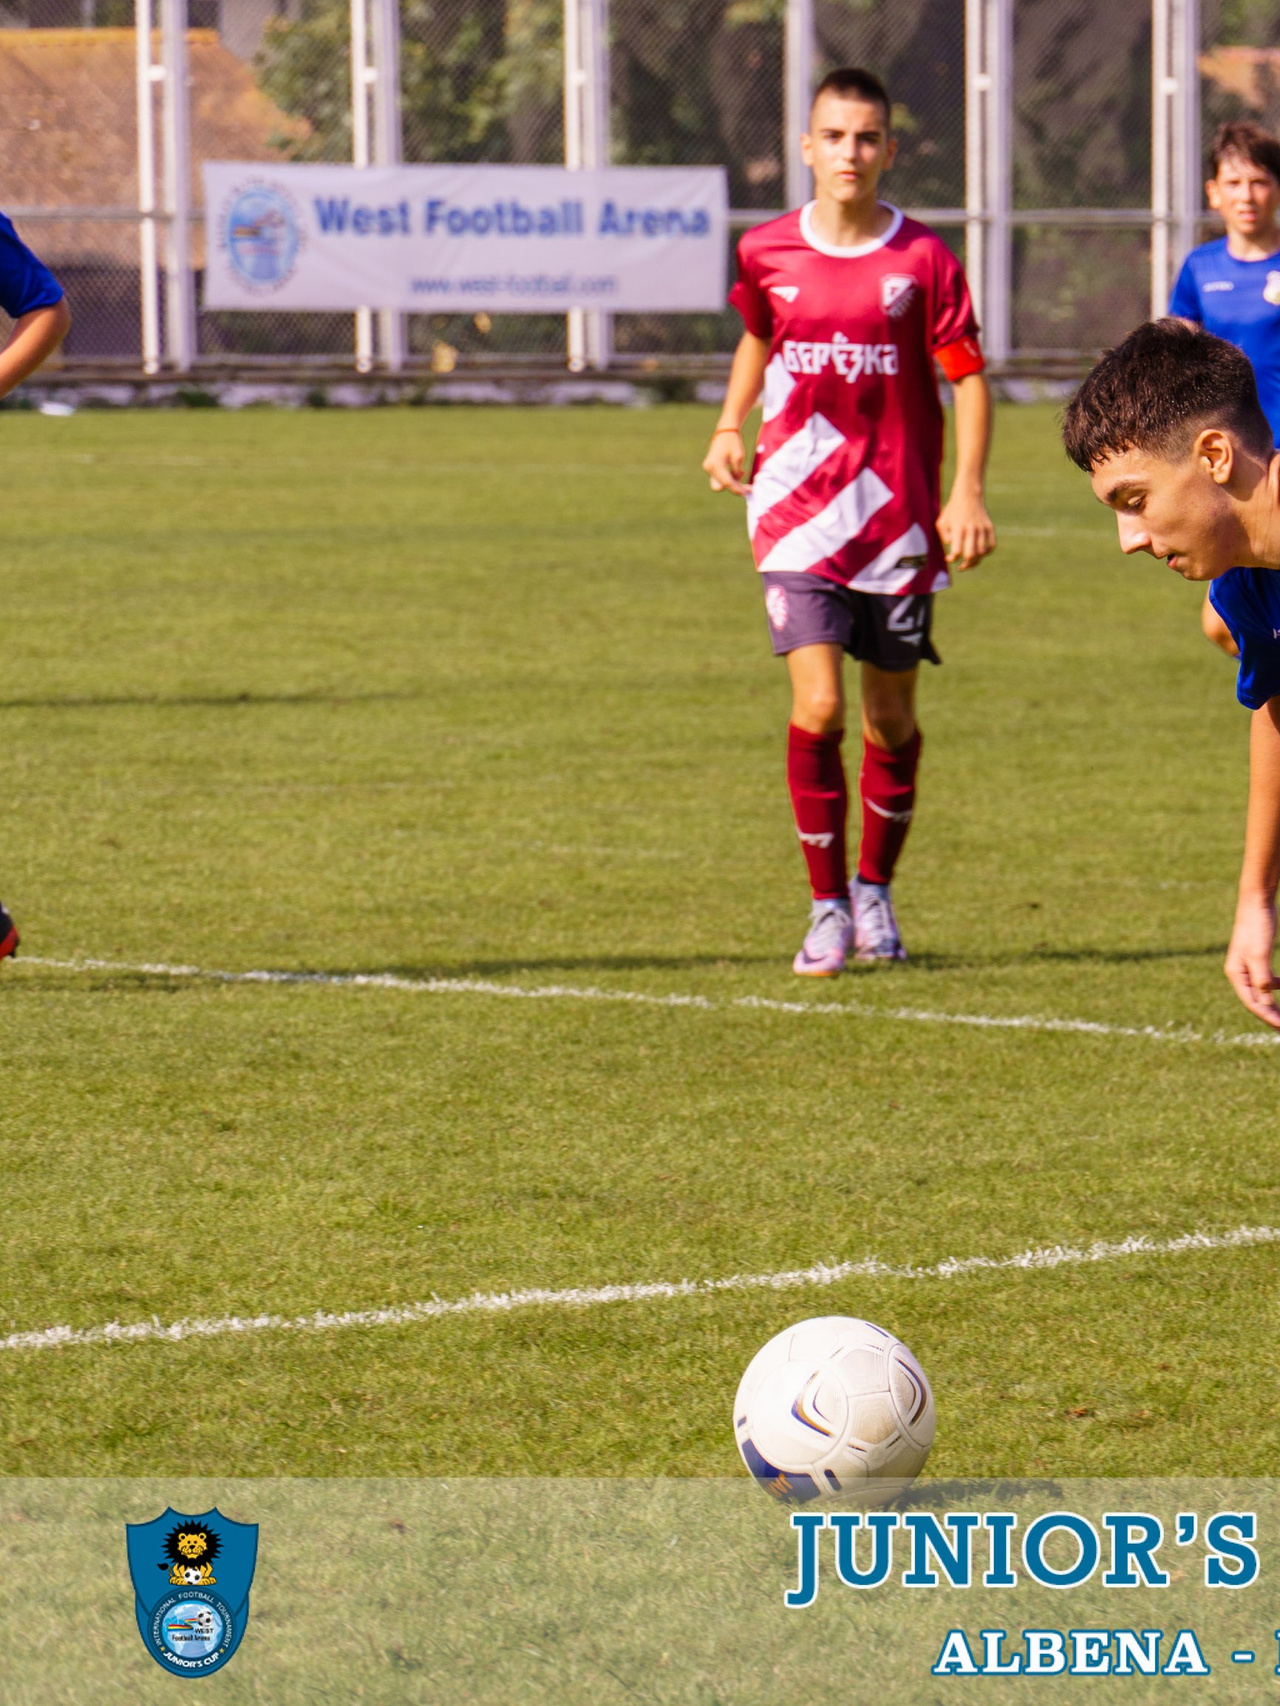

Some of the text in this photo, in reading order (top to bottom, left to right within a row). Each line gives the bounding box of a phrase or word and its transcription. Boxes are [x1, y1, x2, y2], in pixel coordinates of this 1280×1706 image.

[314, 196, 711, 238] West Football Arena
